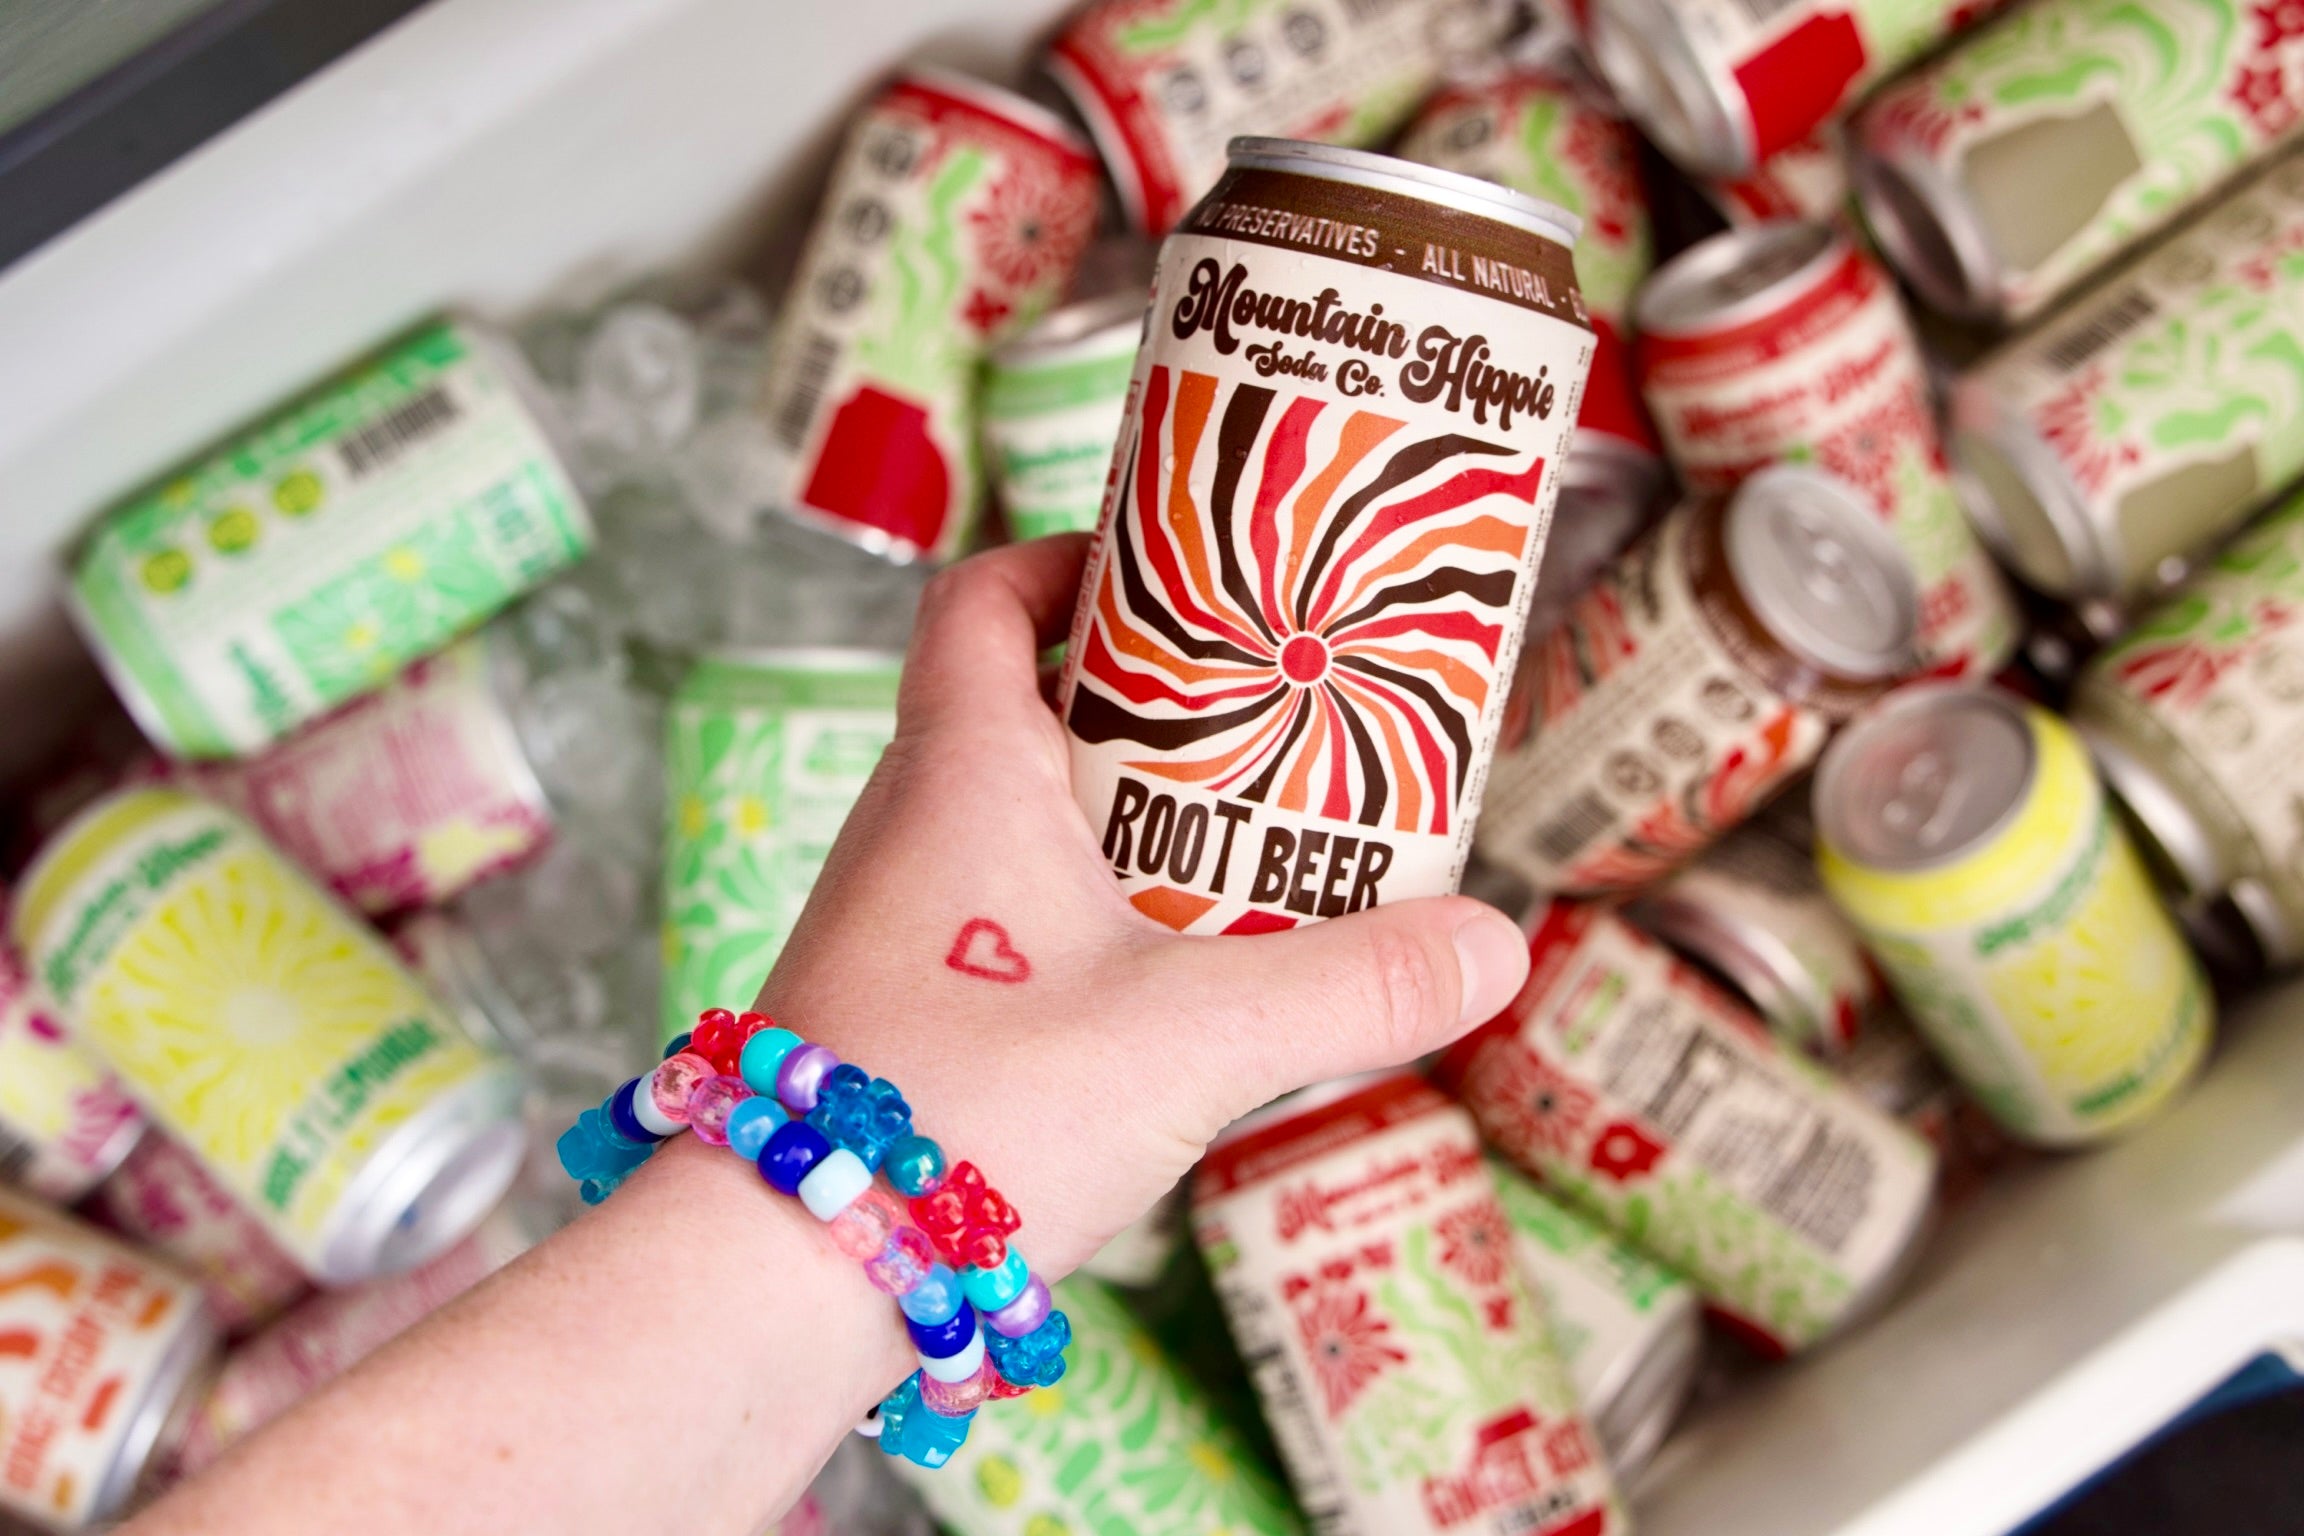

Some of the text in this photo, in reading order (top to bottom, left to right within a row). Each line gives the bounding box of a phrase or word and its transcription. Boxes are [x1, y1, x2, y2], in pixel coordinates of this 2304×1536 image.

[1216, 204, 1379, 258] PRESERVATIVES
[1421, 243, 1466, 281] ALL
[1472, 255, 1555, 309] NATURAL
[1172, 257, 1409, 356] Mountain
[1400, 325, 1554, 431] Hippie
[1245, 341, 1386, 398] Soda Co.
[1102, 777, 1393, 918] ROOT BEER
